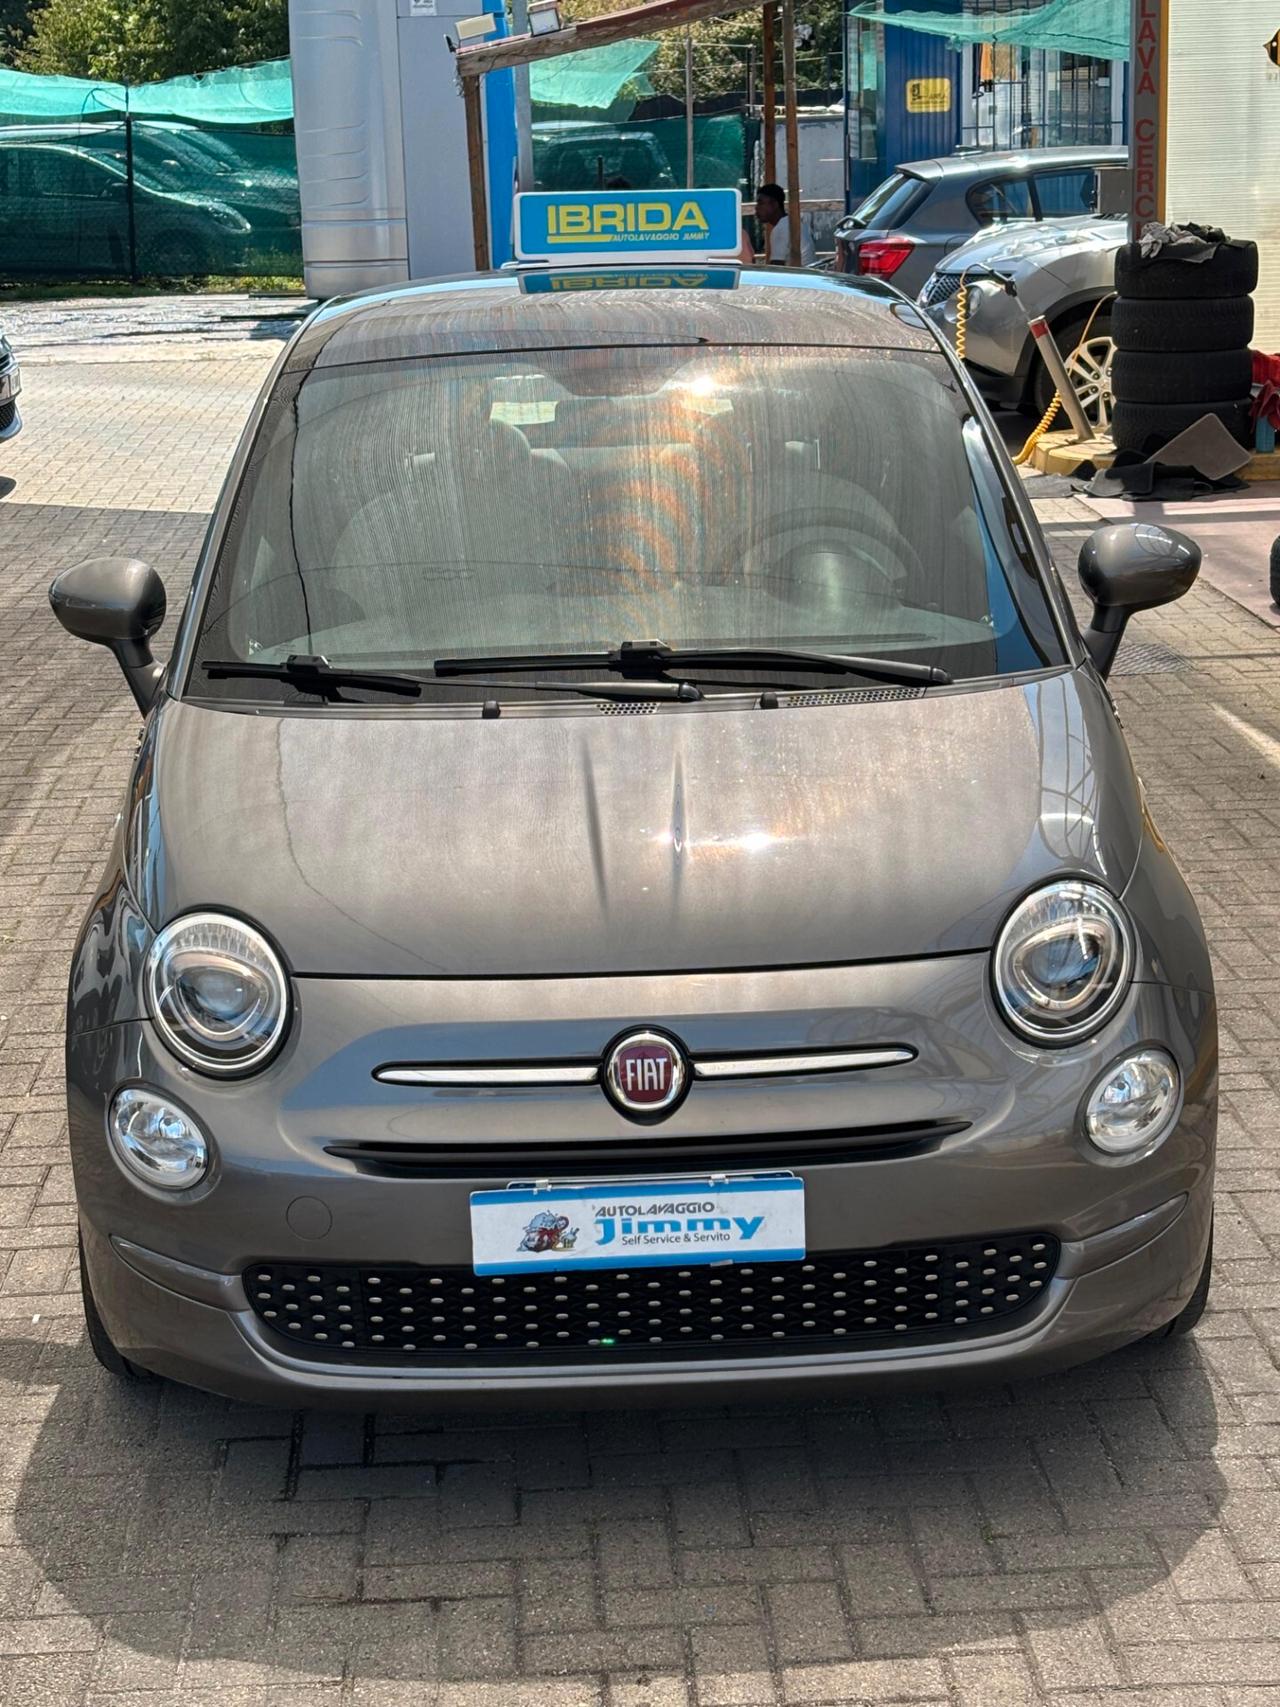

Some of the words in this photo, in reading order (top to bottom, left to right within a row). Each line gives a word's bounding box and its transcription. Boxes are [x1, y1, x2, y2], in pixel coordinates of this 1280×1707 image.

[1137, 0, 1156, 95] LAVA
[546, 201, 709, 234] IBRIDA
[612, 232, 679, 242] AUTOLAVAGGIO
[626, 1057, 668, 1091] FIAT
[595, 1201, 715, 1218] AUTOLAVAGGIO
[593, 1216, 765, 1246] Jimmy
[622, 1234, 641, 1246] Self
[643, 1232, 681, 1245] Service
[683, 1232, 692, 1243] &
[693, 1230, 731, 1243] Servito
